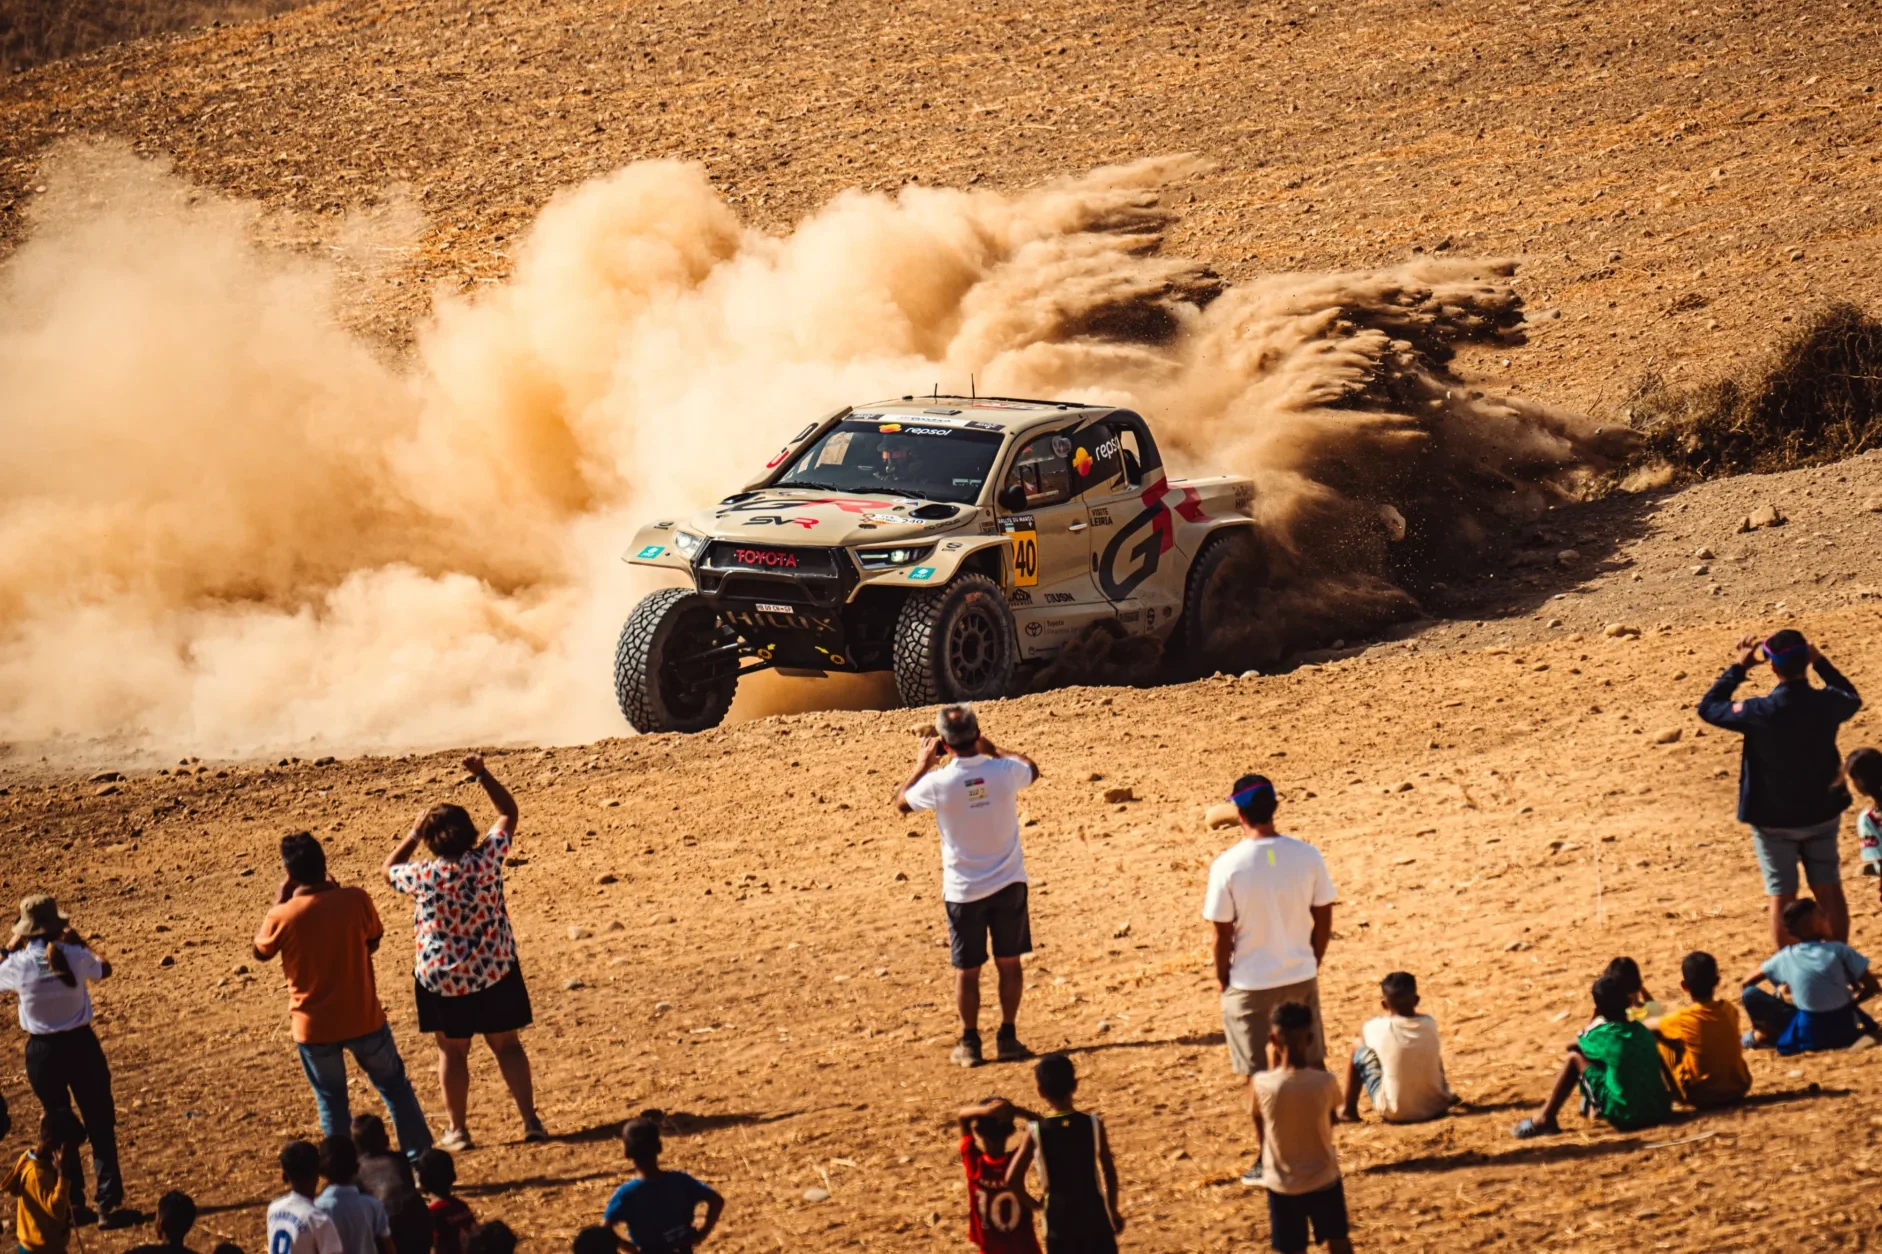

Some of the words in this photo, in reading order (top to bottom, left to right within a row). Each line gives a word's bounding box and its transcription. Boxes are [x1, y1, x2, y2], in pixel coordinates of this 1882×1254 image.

[904, 427, 952, 436] repsol
[1091, 508, 1109, 516] VISITE
[741, 515, 819, 529] SVR
[1090, 516, 1113, 526] LEIRIA
[735, 549, 798, 567] TOYOTA
[1011, 539, 1037, 577] 40
[975, 1189, 1020, 1232] 10
